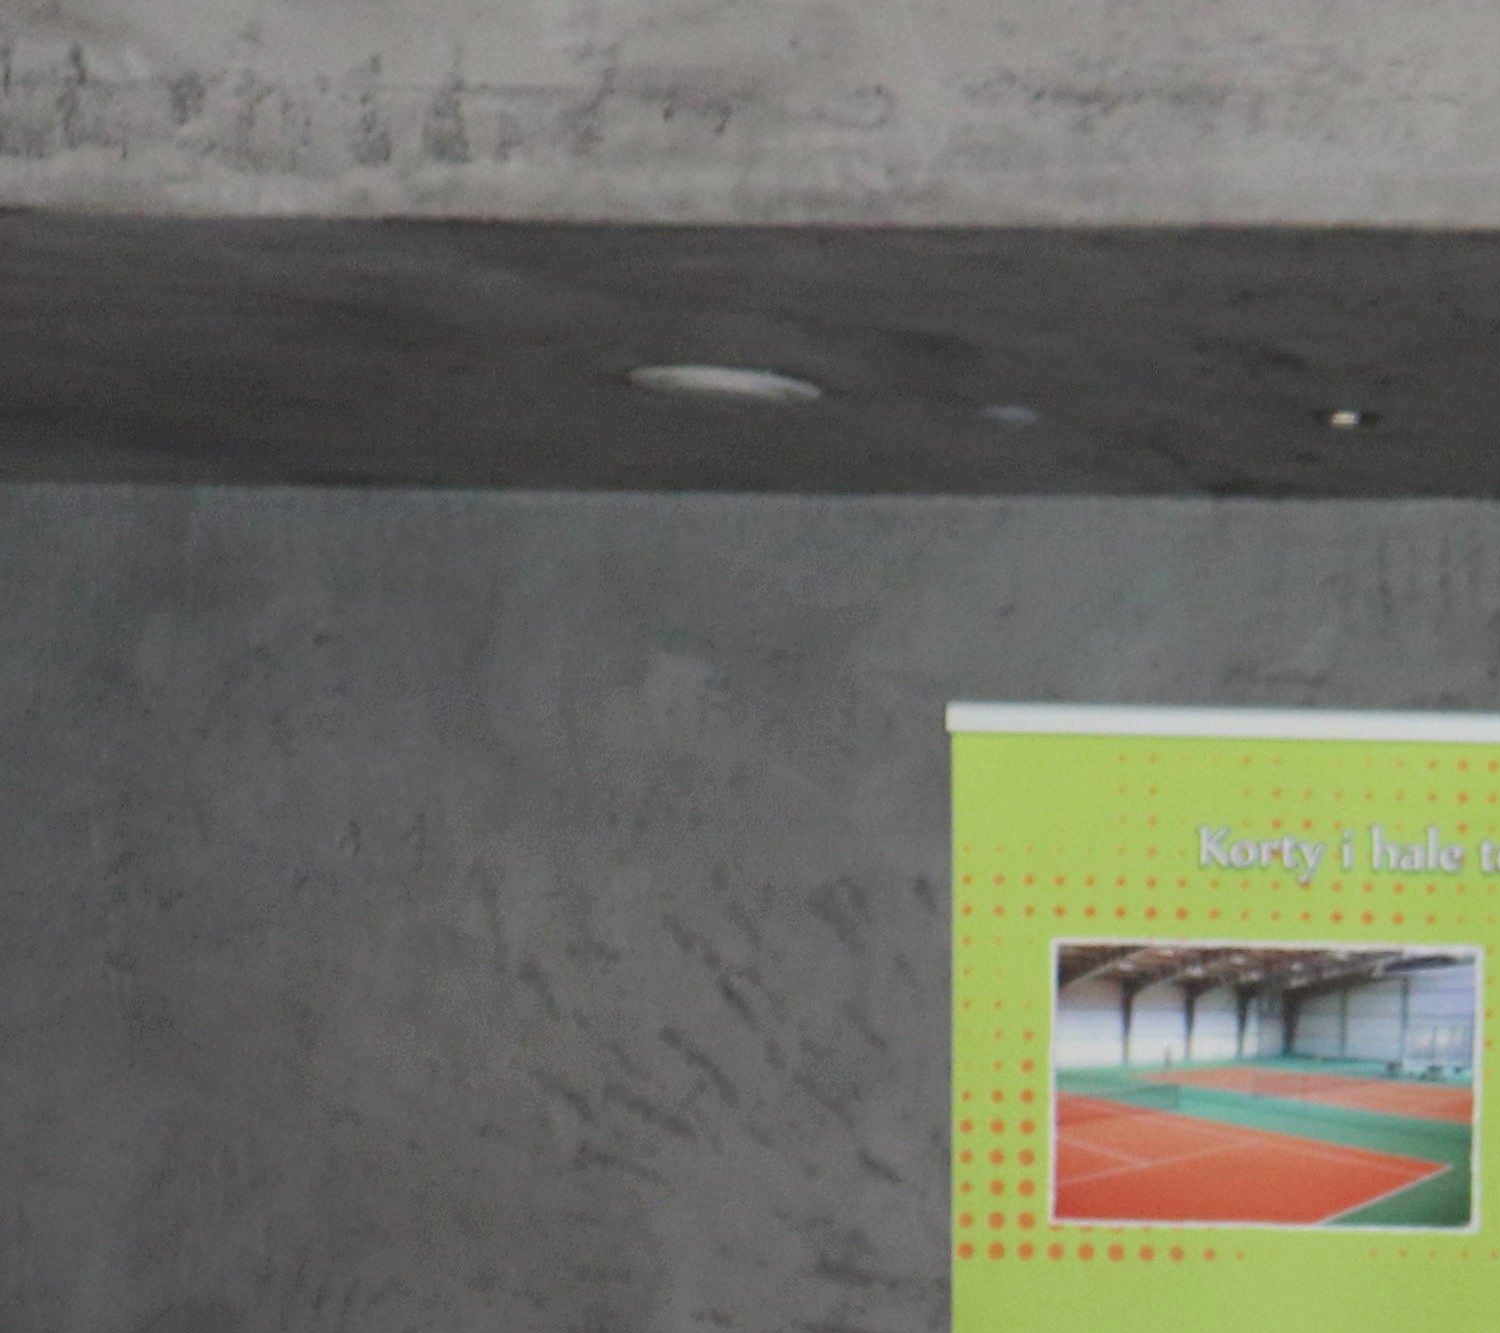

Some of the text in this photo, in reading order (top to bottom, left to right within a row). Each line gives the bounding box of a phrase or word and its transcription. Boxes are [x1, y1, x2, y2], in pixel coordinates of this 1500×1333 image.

[1199, 824, 1326, 885] Korty
[1340, 830, 1354, 869] i
[1370, 825, 1464, 873] hale
